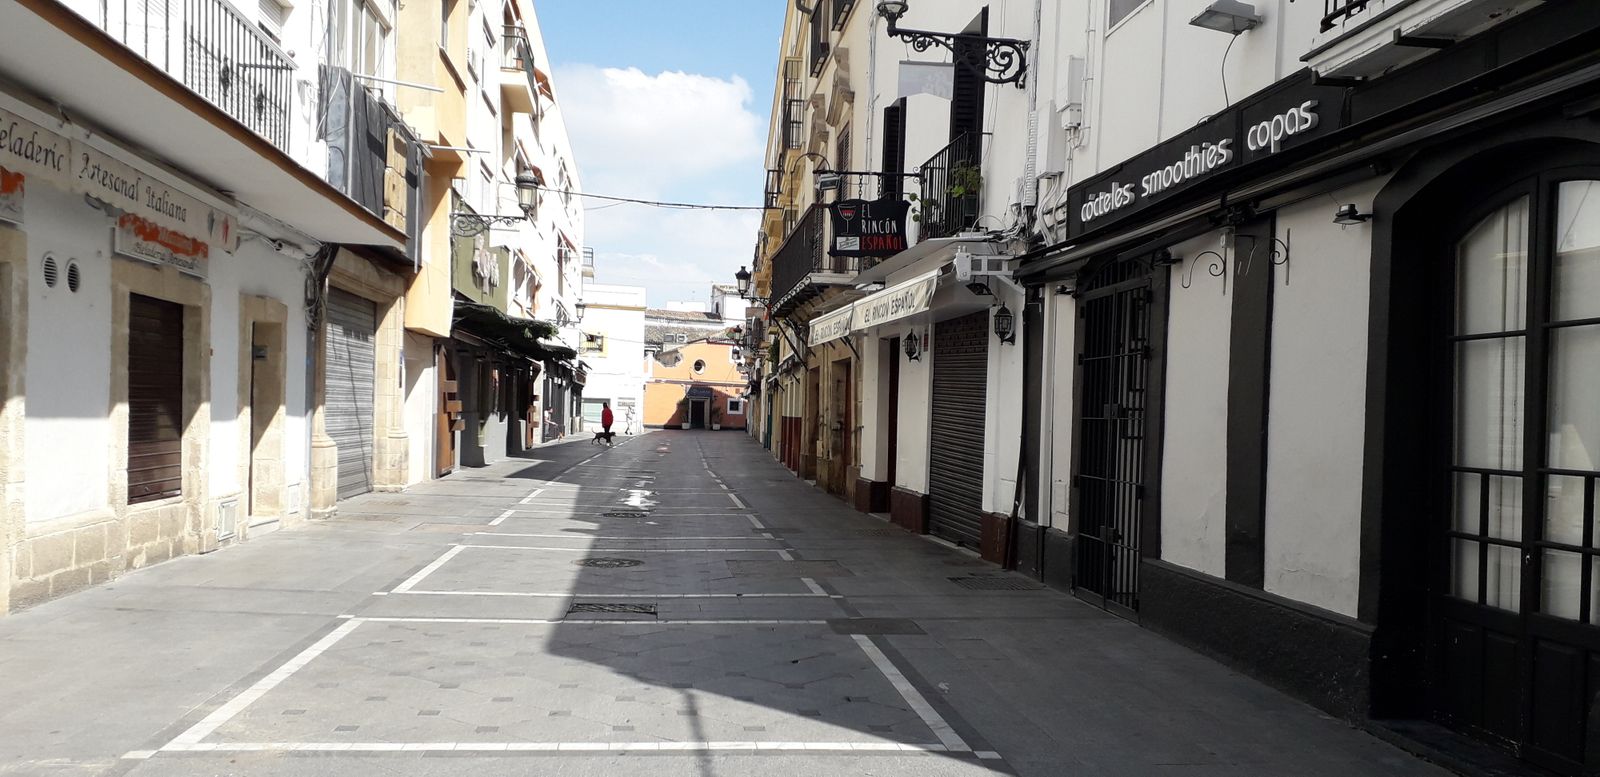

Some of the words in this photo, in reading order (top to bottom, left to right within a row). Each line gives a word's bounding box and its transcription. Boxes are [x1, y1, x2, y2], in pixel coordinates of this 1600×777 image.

[1141, 139, 1233, 197] smoothies
[1247, 100, 1319, 153] copas
[79, 152, 141, 202] Artesanal
[861, 203, 872, 218] EL
[861, 217, 898, 234] RINCÓN
[861, 235, 903, 250] ESPAÑOL
[864, 308, 870, 323] EL
